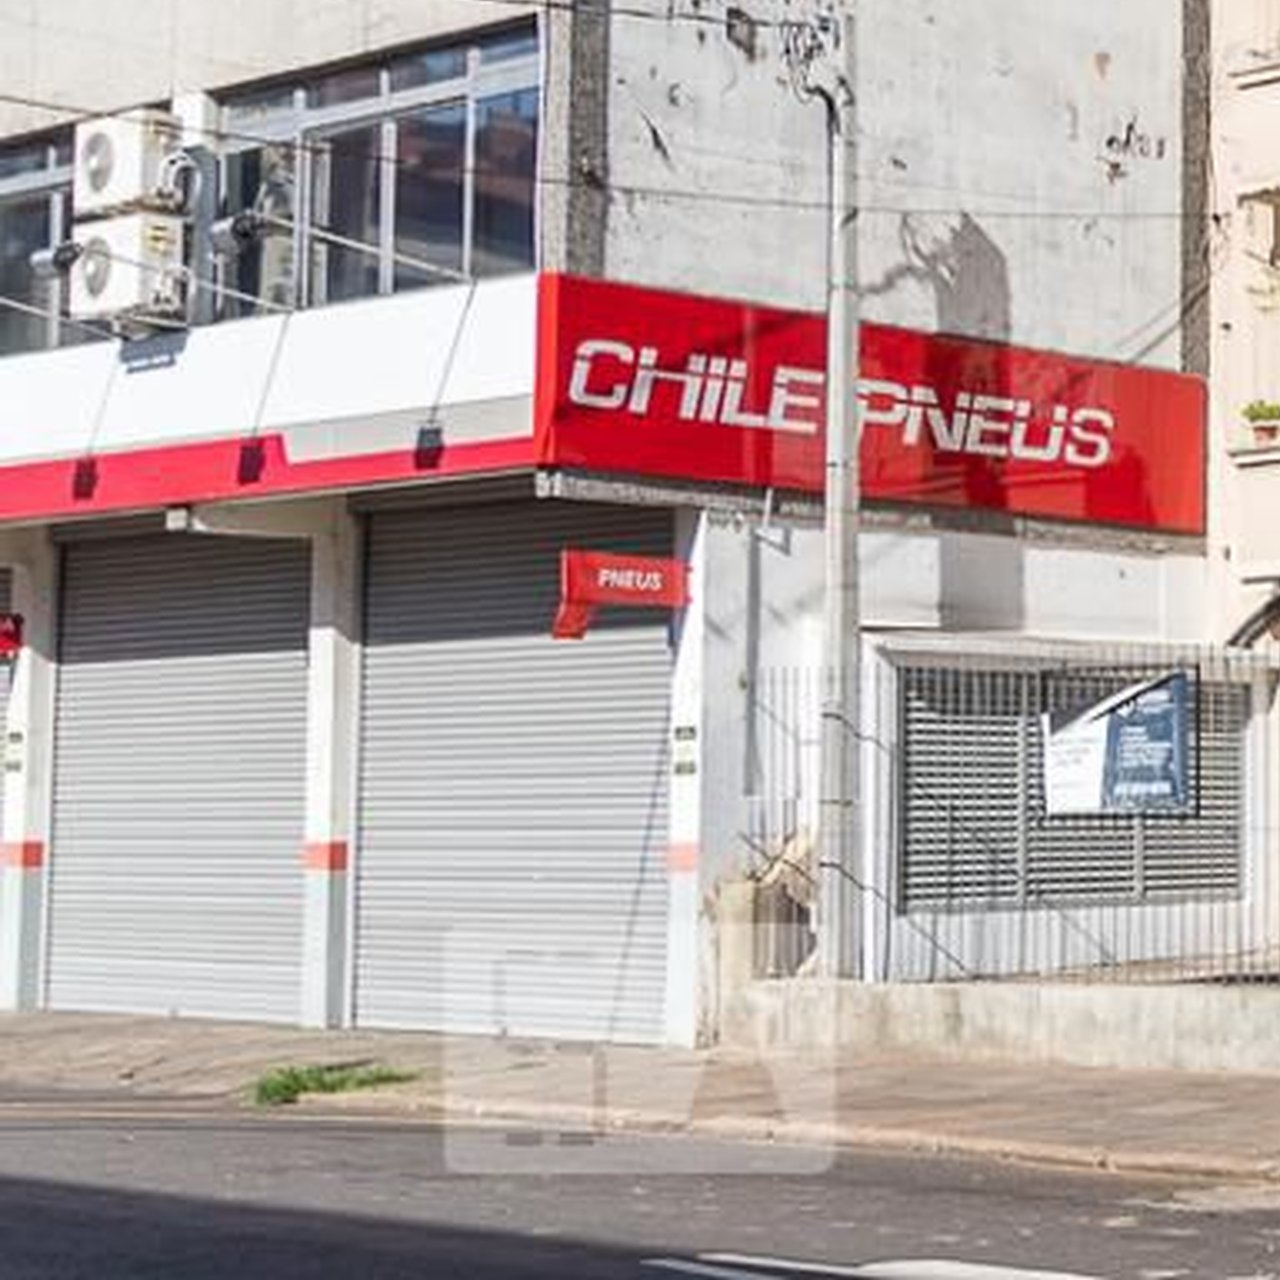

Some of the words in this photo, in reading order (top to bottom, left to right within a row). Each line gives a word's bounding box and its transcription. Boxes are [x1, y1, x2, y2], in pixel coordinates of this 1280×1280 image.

[568, 339, 825, 434] CHILE
[855, 378, 1115, 467] PNEUS
[597, 568, 663, 592] PNEUS
